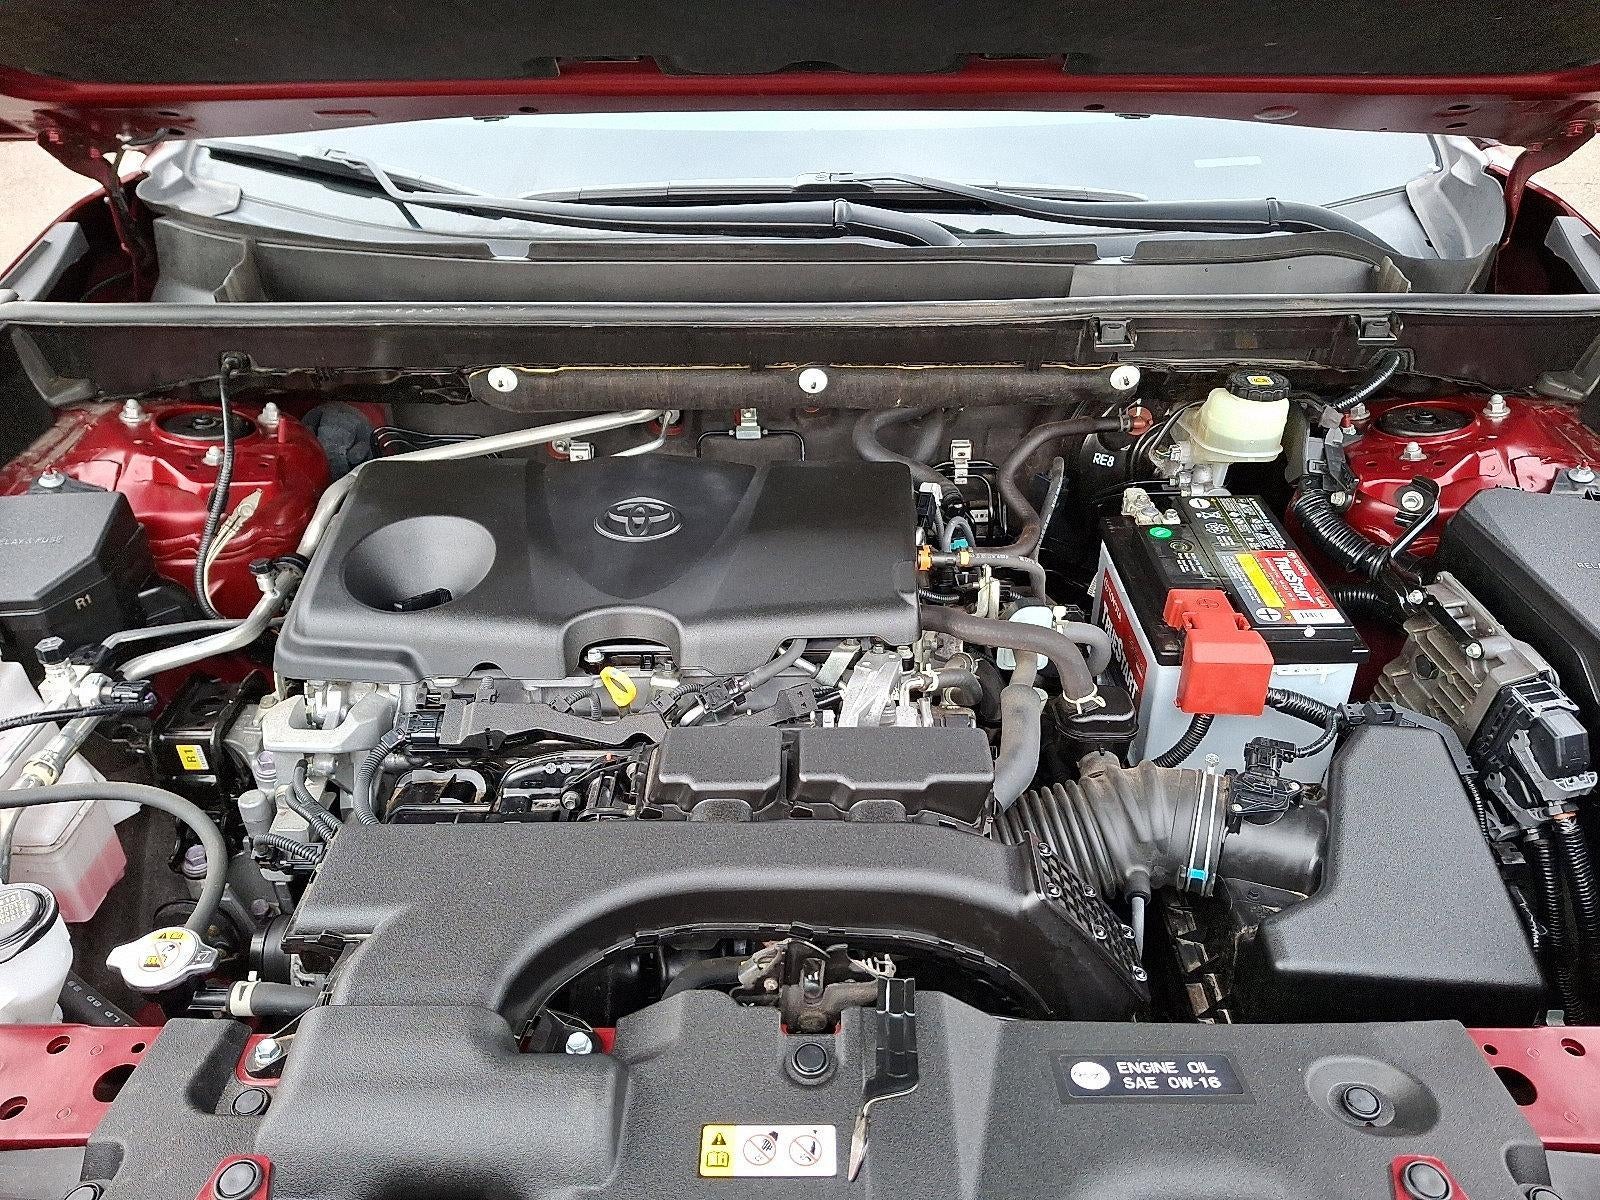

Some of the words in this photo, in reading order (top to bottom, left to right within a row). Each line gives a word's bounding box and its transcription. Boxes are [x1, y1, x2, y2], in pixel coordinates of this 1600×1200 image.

[1092, 452, 1115, 468] RE8
[75, 594, 93, 610] R1
[1116, 1061, 1179, 1075] ENGINE
[1186, 1061, 1216, 1074] OIL
[1122, 1076, 1159, 1090] SAE
[1167, 1076, 1222, 1090] 0W-16
